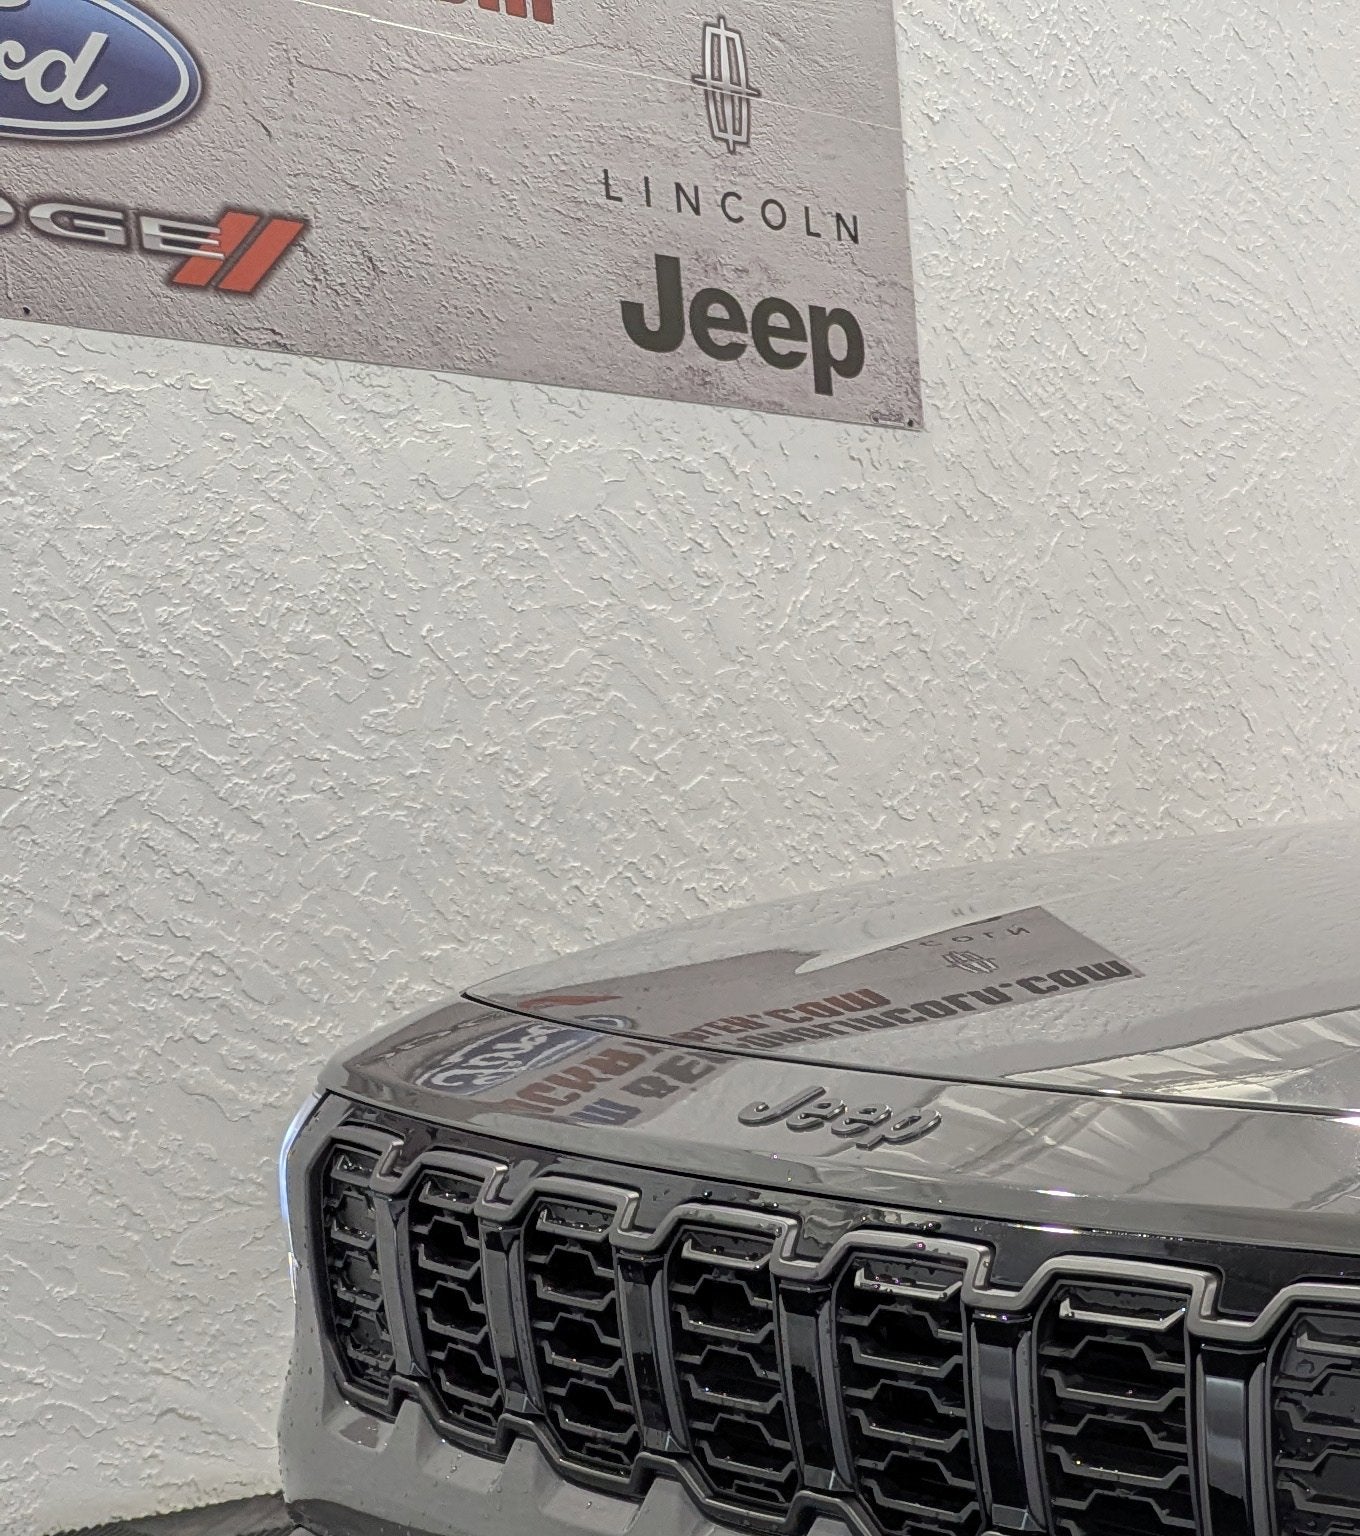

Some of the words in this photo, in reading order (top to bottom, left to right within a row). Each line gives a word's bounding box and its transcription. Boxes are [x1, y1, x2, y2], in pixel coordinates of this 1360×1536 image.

[602, 168, 860, 244] LINCOLN
[620, 253, 865, 396] Jeep
[738, 1086, 943, 1151] Jeep
